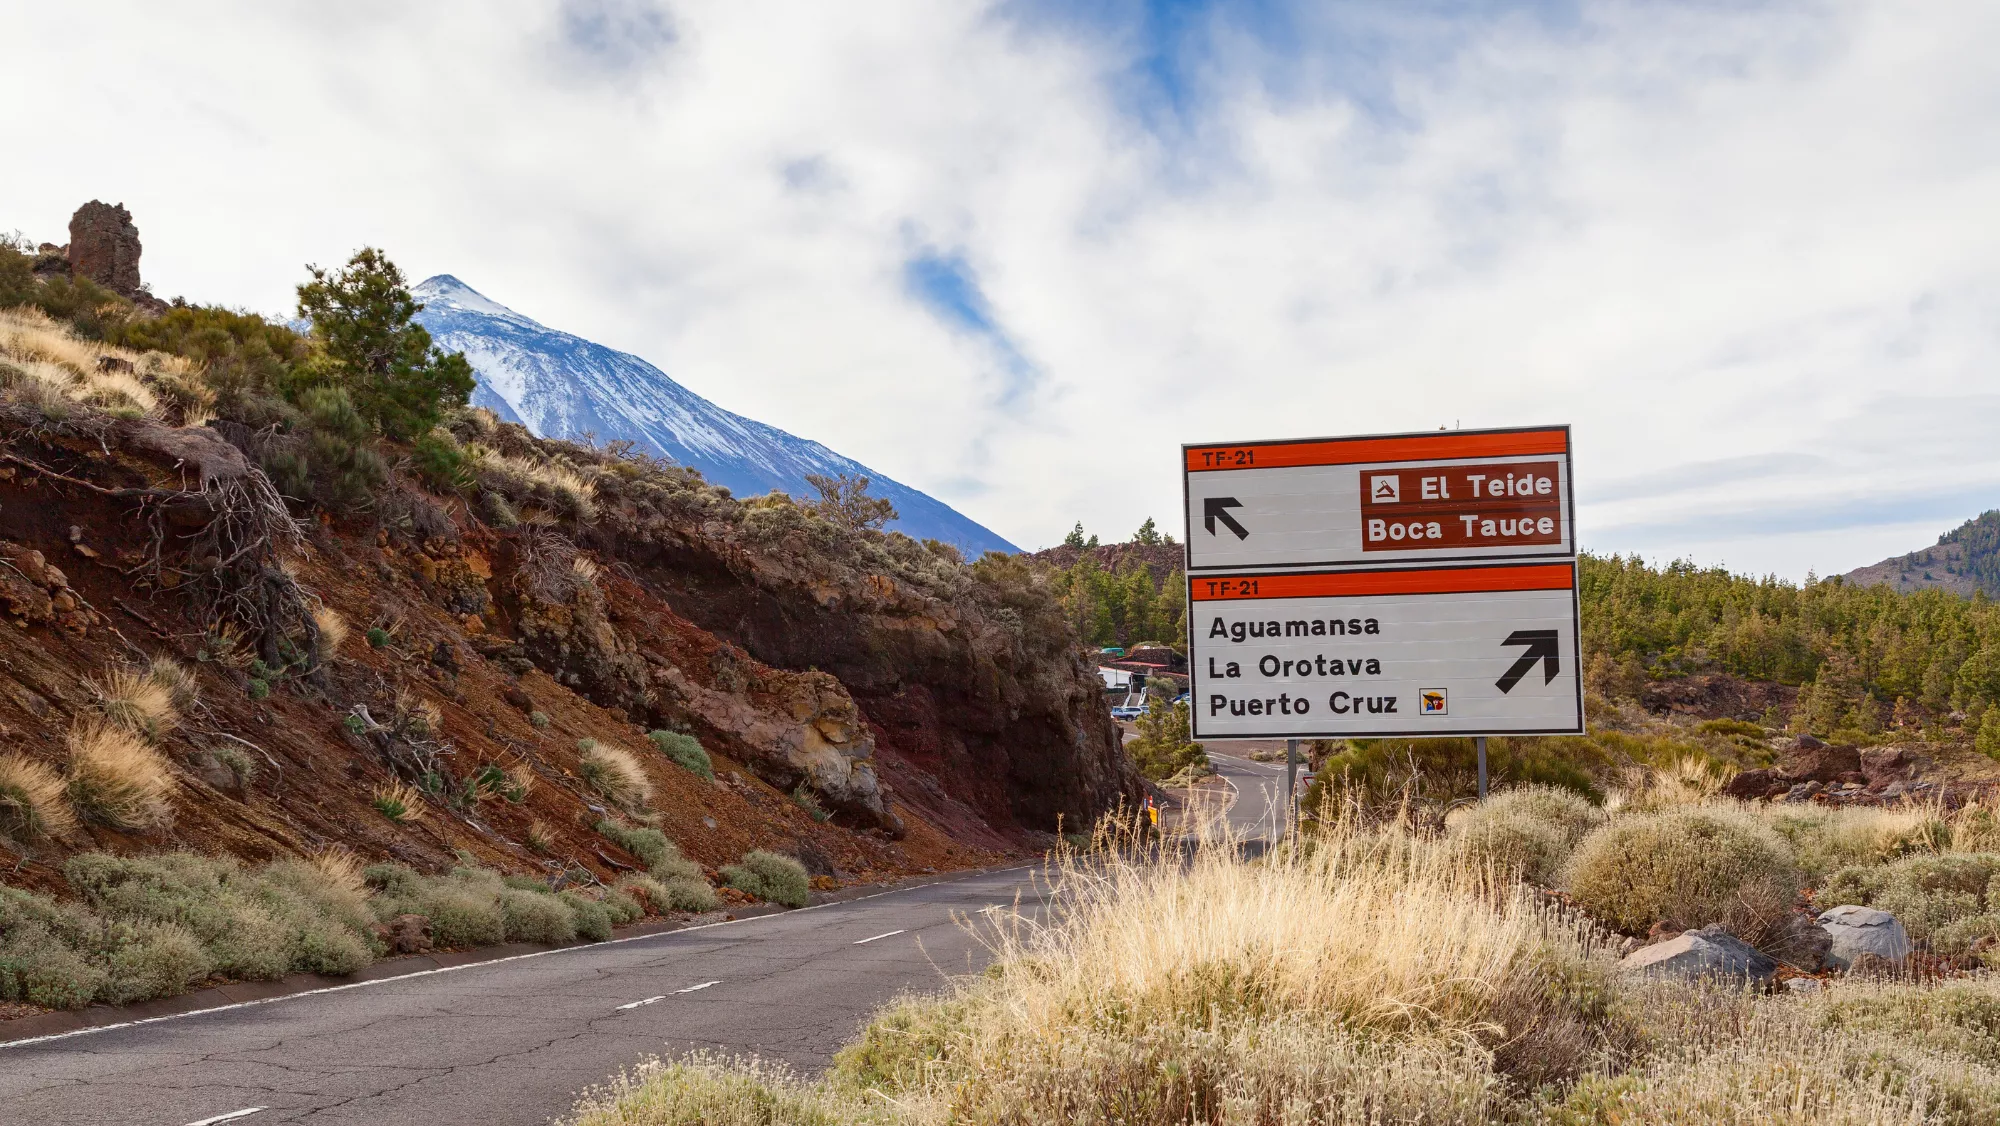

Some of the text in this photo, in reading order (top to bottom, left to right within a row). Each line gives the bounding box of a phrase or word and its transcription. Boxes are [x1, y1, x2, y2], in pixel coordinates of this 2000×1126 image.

[1202, 450, 1254, 466] TF-21
[1422, 473, 1551, 499] El Teide
[1369, 515, 1553, 541] Boca Tauce
[1207, 581, 1259, 597] TF-21
[1209, 617, 1380, 643] Aguamansa
[1209, 654, 1381, 678] La Orotava
[1211, 691, 1397, 716] Puerto Cruz
